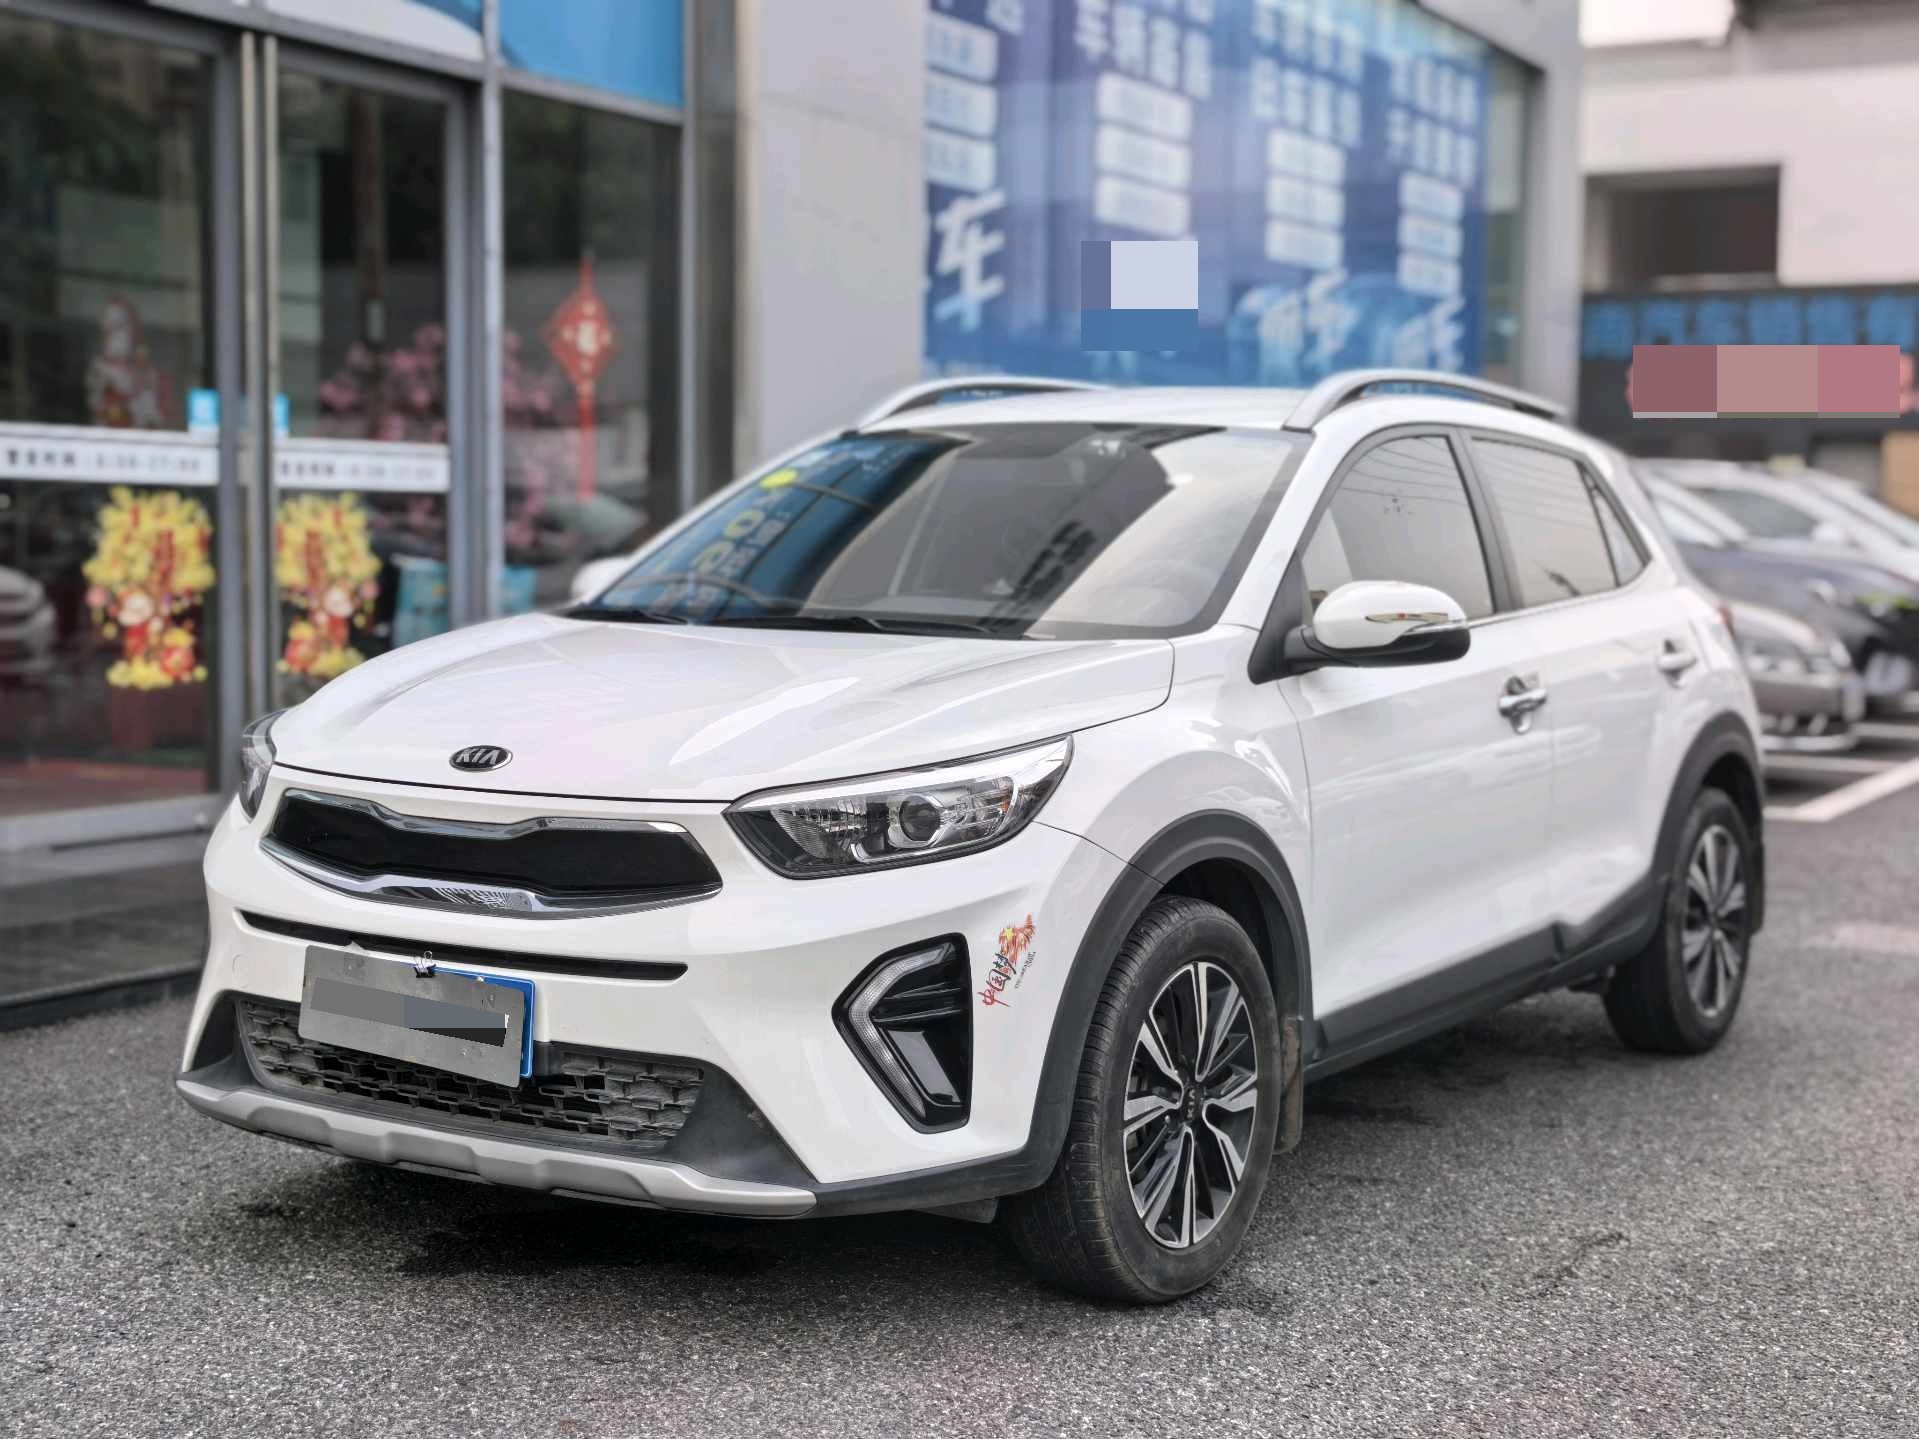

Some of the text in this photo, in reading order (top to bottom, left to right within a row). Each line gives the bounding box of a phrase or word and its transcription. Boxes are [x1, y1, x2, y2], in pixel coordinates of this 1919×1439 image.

[456, 748, 500, 765] KIA
[976, 951, 1017, 1008] 中国梦
